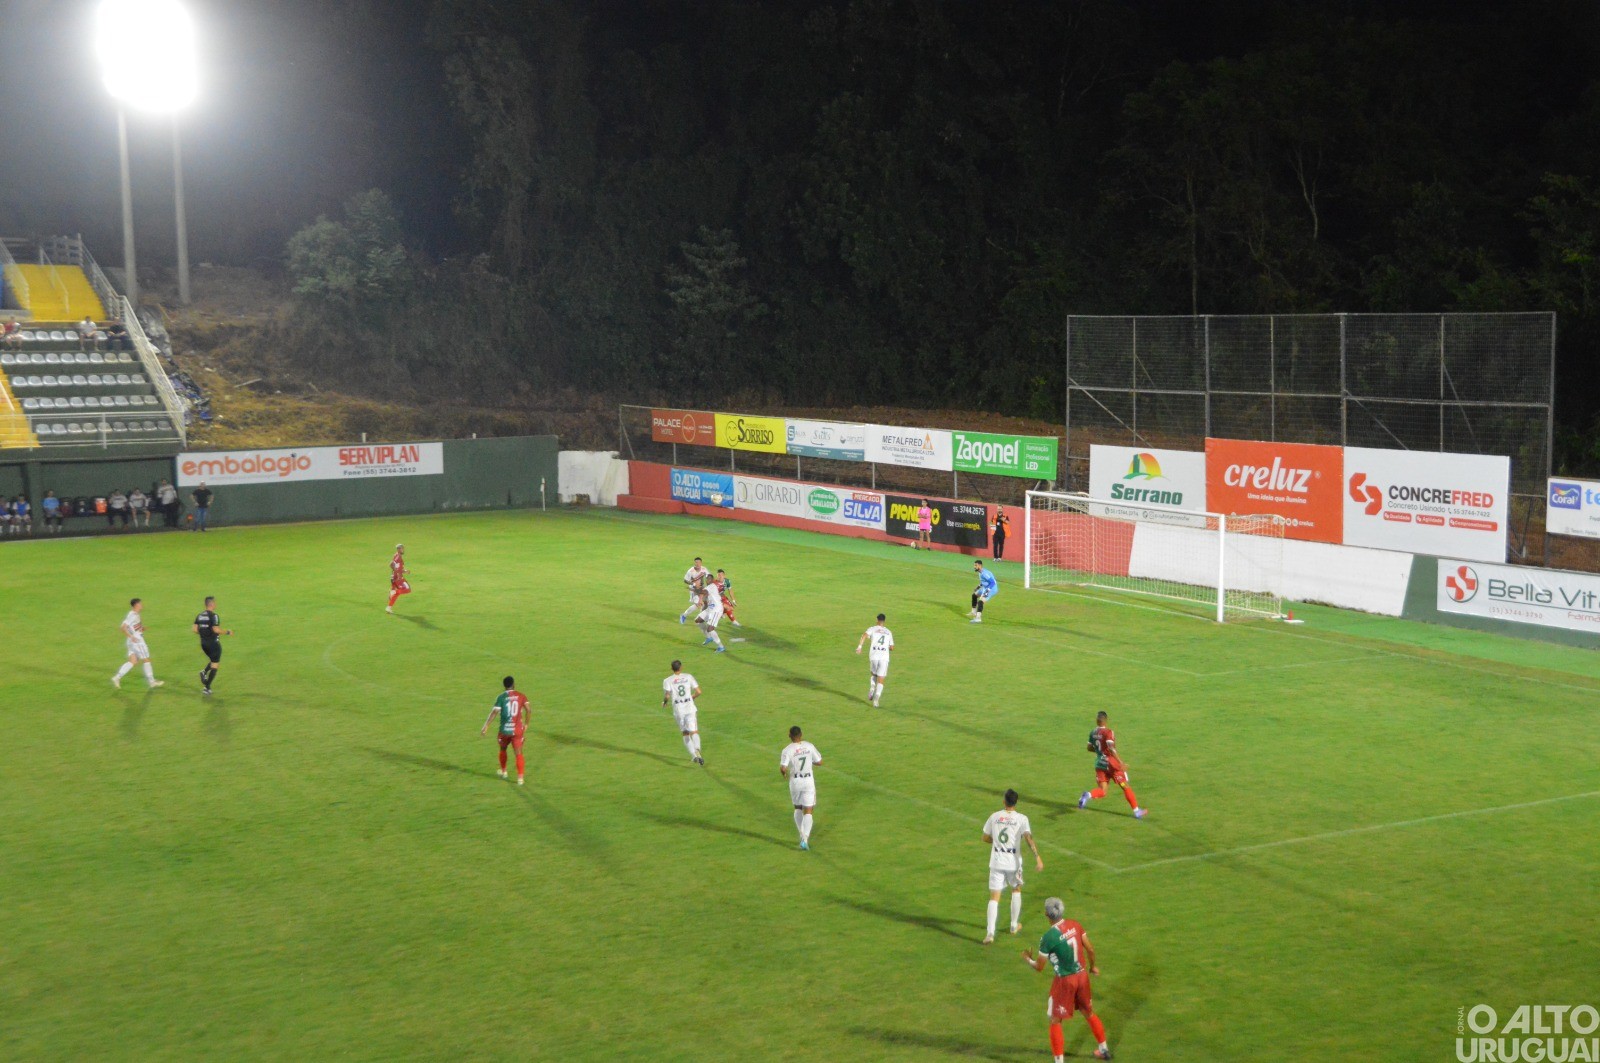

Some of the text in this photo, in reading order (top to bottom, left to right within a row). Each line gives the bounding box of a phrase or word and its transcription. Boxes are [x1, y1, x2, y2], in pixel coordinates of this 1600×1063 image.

[653, 418, 681, 428] PALACE
[738, 418, 774, 445] SORRISO
[882, 435, 923, 447] METALFRED
[338, 444, 420, 466] SERVIPLAN
[955, 434, 1019, 468] Zagonel
[181, 454, 312, 477] embalagio
[1025, 461, 1039, 471] LED
[674, 473, 682, 485] O
[681, 474, 701, 488] ALTO
[1224, 456, 1312, 493] creluz
[672, 486, 701, 500] URUGUAI
[755, 483, 801, 505] GIRARDI
[853, 493, 880, 503] MERCADO
[1111, 483, 1183, 506] Serrano
[1285, 496, 1307, 504] ilumina
[1388, 485, 1494, 509] CONCREFRED
[1552, 493, 1575, 505] Coral
[844, 501, 880, 520] SILVA
[890, 503, 940, 525] PIONEO
[1387, 500, 1419, 512] Concreto
[1419, 504, 1446, 513] Usinado
[1389, 513, 1411, 521] Qualidade
[1422, 516, 1443, 524] Agilidade
[1488, 579, 1600, 610] Bella Vit
[877, 635, 885, 646] 4
[677, 685, 686, 697] 8
[505, 700, 519, 718] 10
[798, 756, 807, 772] 7
[998, 827, 1009, 844] 6
[1066, 936, 1079, 963] 7
